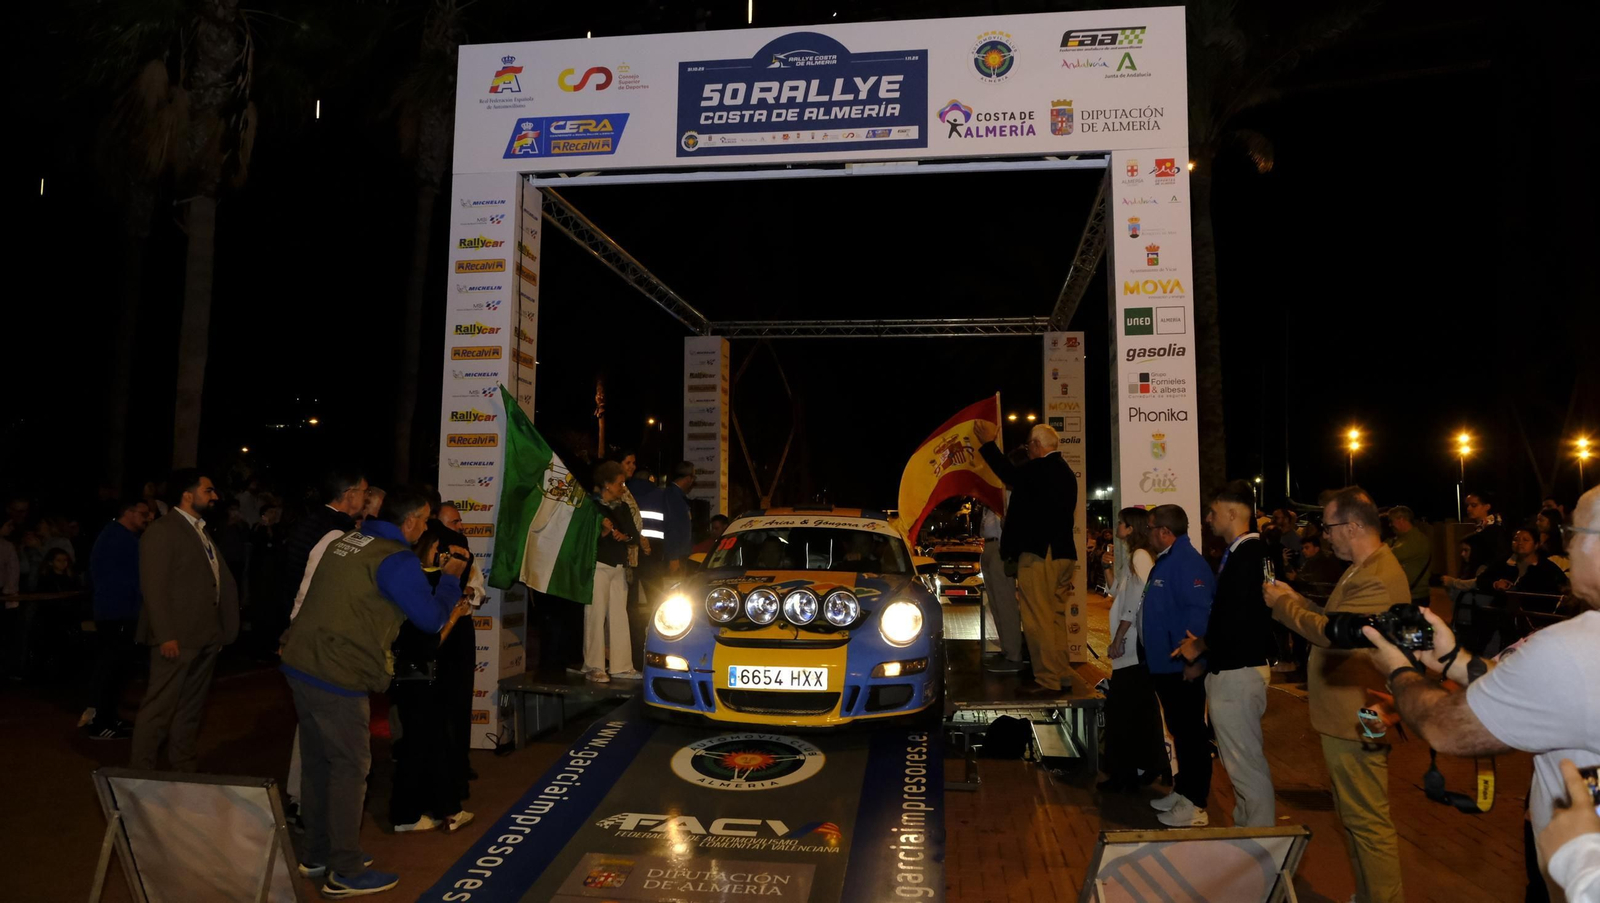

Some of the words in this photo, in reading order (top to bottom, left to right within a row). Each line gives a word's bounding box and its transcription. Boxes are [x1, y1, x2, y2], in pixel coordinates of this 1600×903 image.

[700, 82, 746, 107] 50
[750, 75, 905, 105] RALLYE
[699, 109, 767, 125] COSTA
[771, 108, 801, 122] DE
[804, 101, 901, 120] ALMERÍA
[976, 111, 1016, 122] COSTA
[1019, 110, 1035, 120] DE
[1081, 105, 1164, 121] DIPUTACIÓN
[550, 118, 614, 134] CERA
[963, 121, 1036, 139] ALMERÍA
[1081, 121, 1098, 134] DE
[1101, 117, 1162, 132] ALMERÍA
[561, 140, 601, 152] Recalvi
[459, 238, 505, 250] Rallycar
[464, 261, 496, 272] Recalvi
[1123, 279, 1185, 296] MOYA
[455, 324, 501, 336] Rallycar
[461, 348, 492, 358] Recalvi
[1126, 344, 1187, 362] gasolia
[1151, 378, 1186, 386] Fornieles
[1152, 386, 1158, 394] &
[1160, 386, 1186, 394] albesa
[451, 410, 497, 422] Rallycar
[1128, 407, 1188, 422] Phonika
[456, 435, 488, 445] Recalvi
[446, 500, 494, 512] allycar
[764, 518, 796, 526] Arias
[740, 669, 783, 686] 6654
[790, 670, 823, 687] HXX
[692, 734, 782, 752] AUTOMOVIL
[790, 740, 818, 757] CLUB
[697, 777, 780, 789] ALMERIA
[686, 834, 701, 843] DE
[704, 835, 799, 847] AUTOMOVILISMO
[770, 843, 841, 854] VALENCIANA
[643, 879, 673, 890] DE
